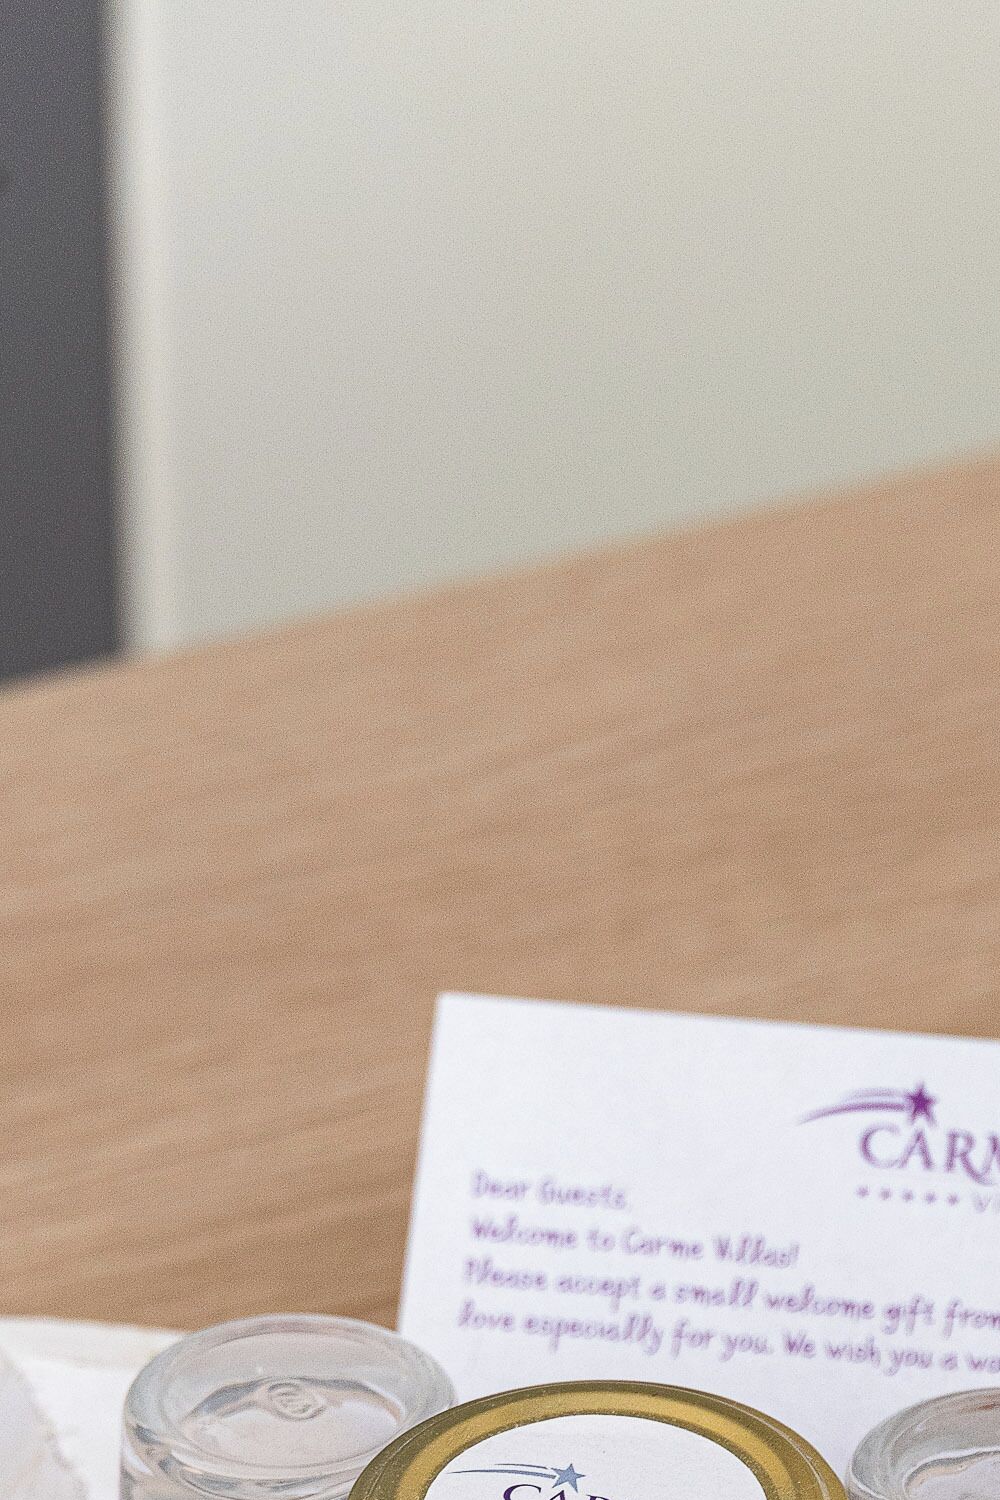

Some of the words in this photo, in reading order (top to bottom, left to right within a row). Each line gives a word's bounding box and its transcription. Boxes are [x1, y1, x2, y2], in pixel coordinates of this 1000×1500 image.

[471, 1169, 529, 1199] Dear
[472, 1213, 577, 1249] Welcome
[587, 1227, 615, 1251] to
[623, 1227, 702, 1260] Carme
[463, 1256, 547, 1290] Please
[556, 1274, 640, 1313] accept
[650, 1283, 666, 1301] a
[674, 1277, 759, 1306] small
[765, 1283, 875, 1320] welcome
[882, 1295, 934, 1335] gift
[458, 1298, 515, 1331] love
[523, 1312, 663, 1356] especially
[670, 1319, 714, 1359] for
[783, 1331, 816, 1359] We
[826, 1338, 881, 1366] wish
[888, 1345, 933, 1376] you
[939, 1352, 959, 1370] a
